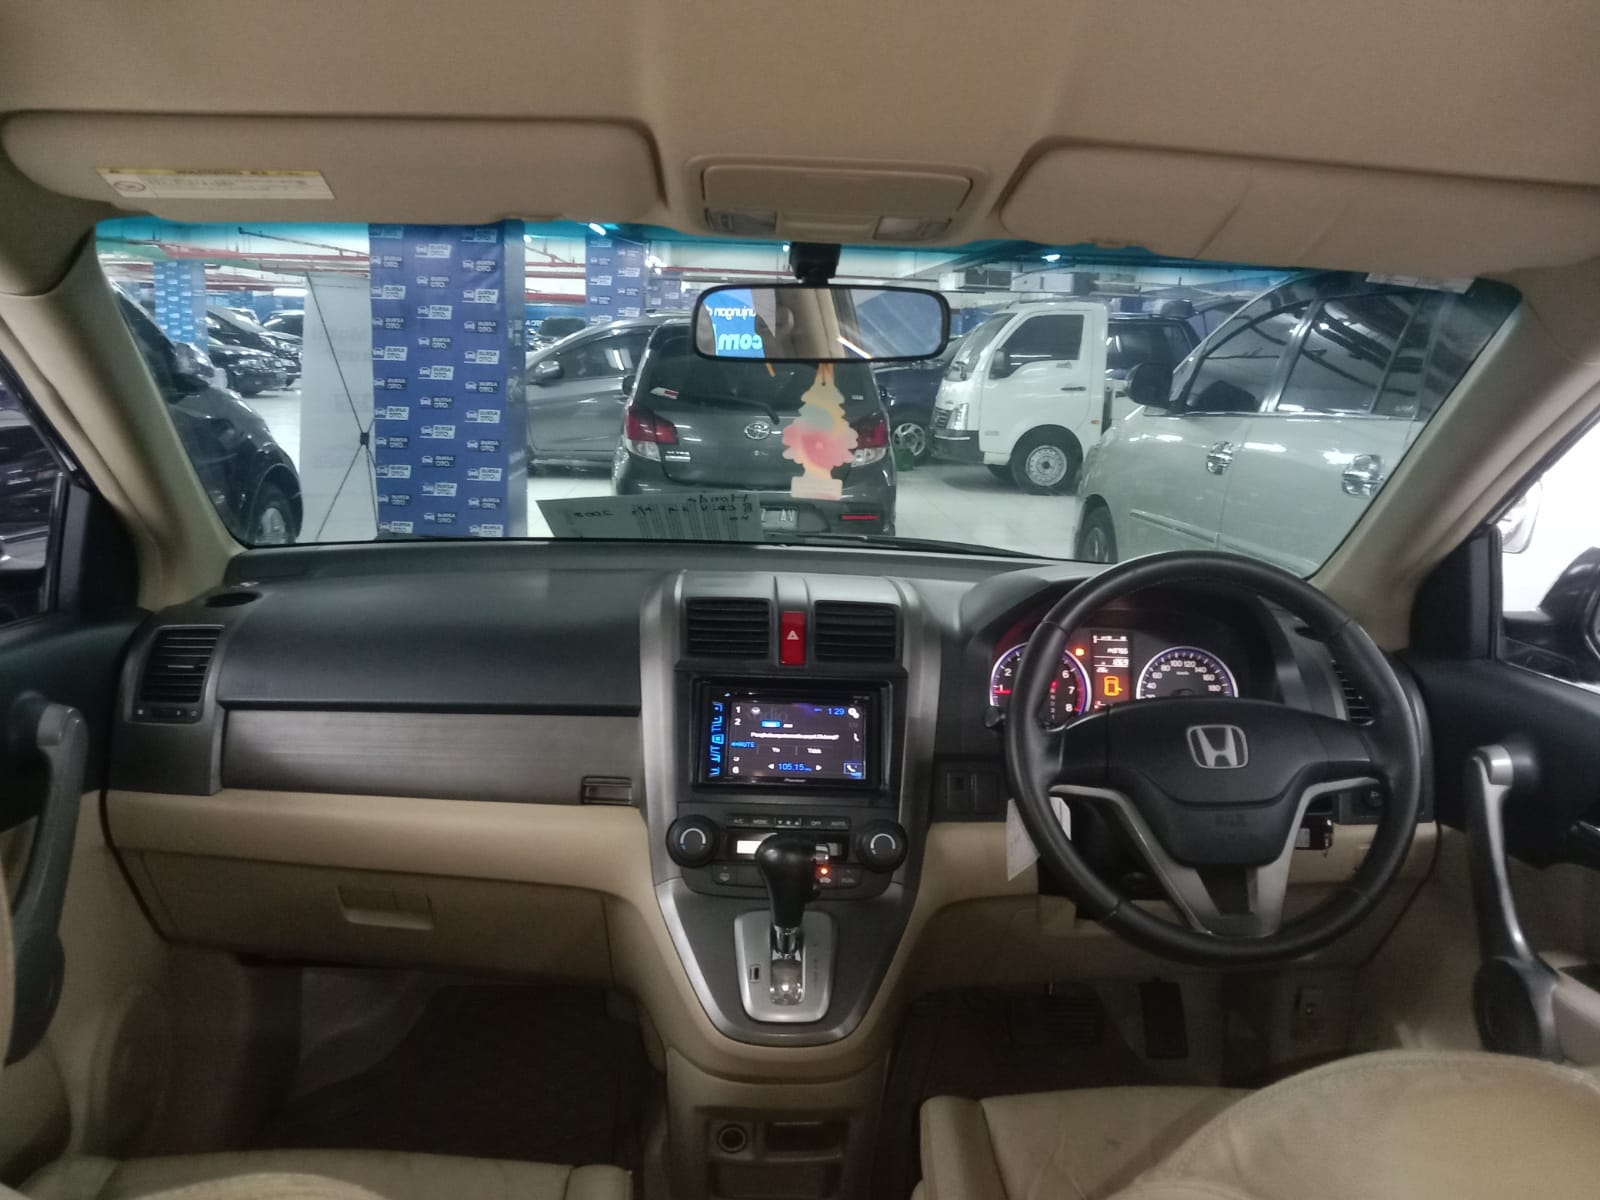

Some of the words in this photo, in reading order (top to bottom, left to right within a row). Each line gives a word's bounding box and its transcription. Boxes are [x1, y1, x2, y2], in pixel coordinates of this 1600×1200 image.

[1170, 659, 1182, 668] 100
[1183, 660, 1196, 668] 120
[1004, 668, 1012, 676] 2
[1160, 664, 1171, 672] 80
[1194, 666, 1207, 674] 140
[1062, 670, 1070, 678] 6
[1203, 674, 1215, 682] 160
[1068, 686, 1075, 695] 7
[1208, 684, 1221, 692] 180
[1065, 703, 1073, 712] 8
[732, 766, 740, 774] 6
